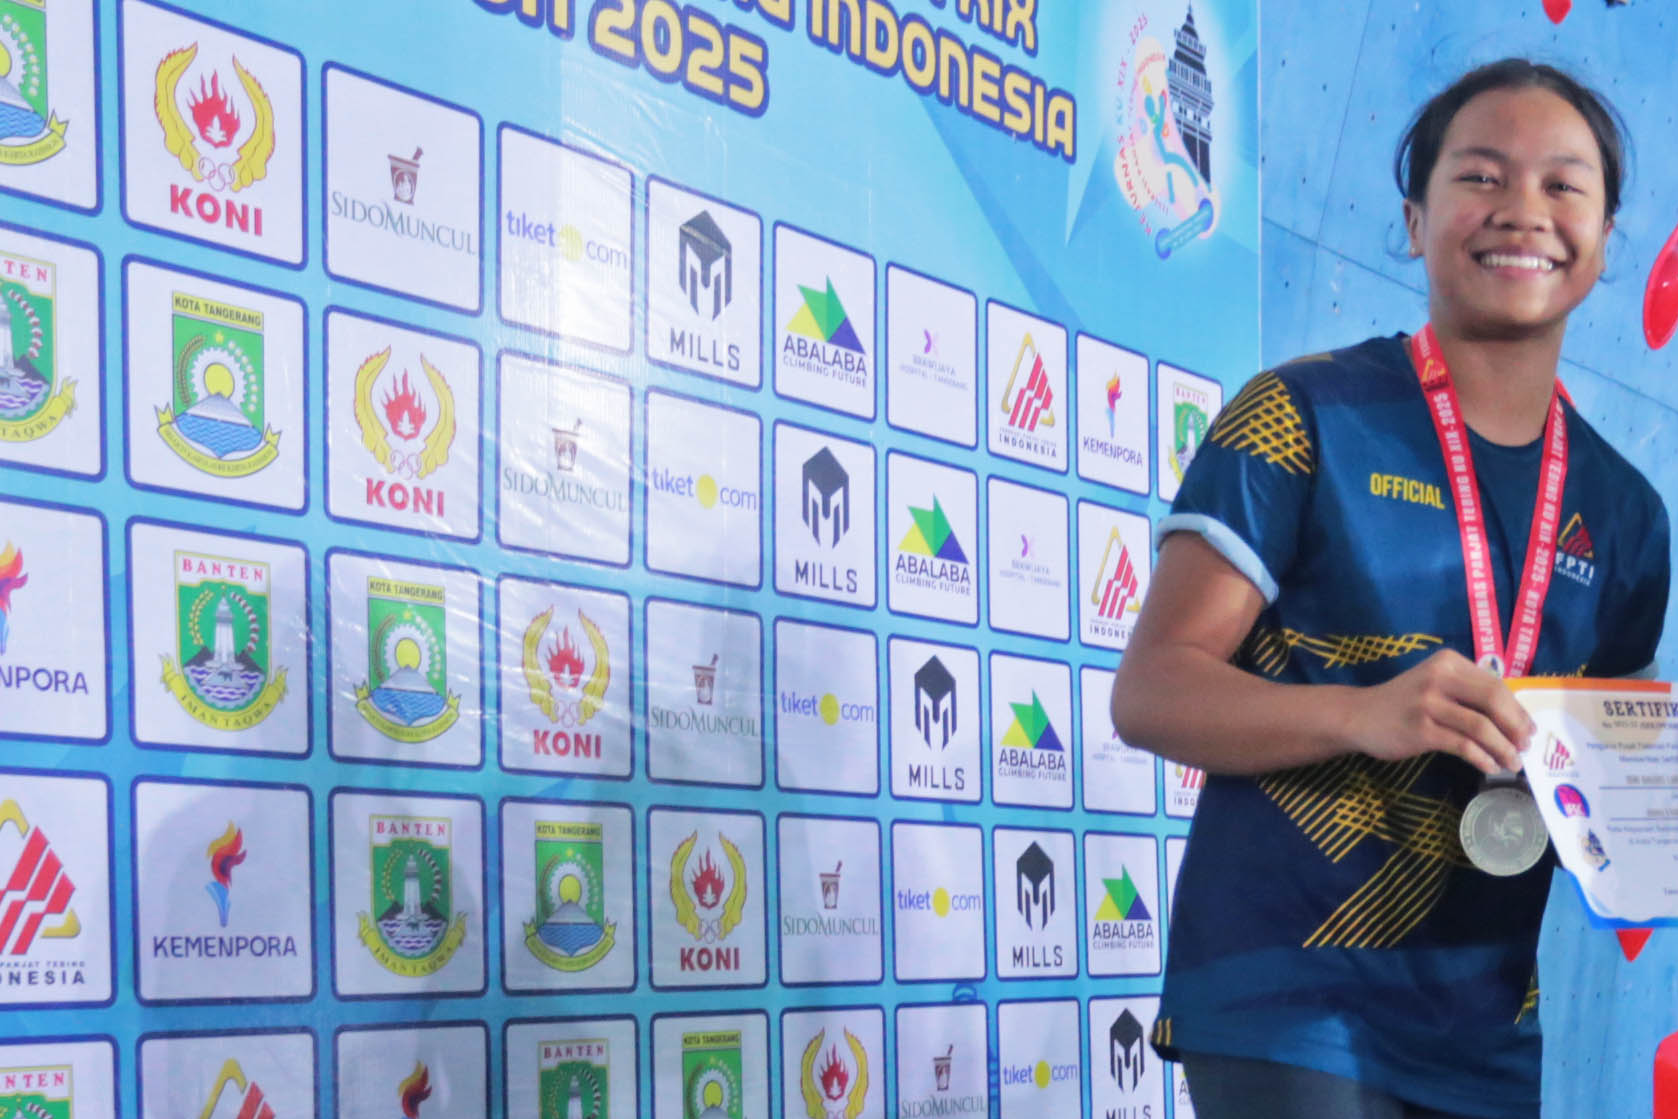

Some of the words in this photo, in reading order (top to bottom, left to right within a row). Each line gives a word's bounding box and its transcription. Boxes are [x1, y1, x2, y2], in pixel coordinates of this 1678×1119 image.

[591, 0, 767, 113] 2025
[809, 0, 1075, 160] INDONESIA
[170, 183, 263, 237] KONI
[332, 190, 478, 257] SIDOMUNCUL
[4, 260, 48, 283] TEN
[174, 296, 201, 313] KOTA
[204, 303, 262, 327] TANGERANG
[670, 327, 740, 372] MILLS
[783, 335, 867, 377] ABALABA
[783, 354, 829, 378] CLIMBING
[832, 366, 866, 388] FUTURE
[999, 433, 1057, 458] INDONESIA
[1083, 435, 1143, 467] KEMENPORA
[365, 477, 445, 518] KONI
[503, 467, 629, 512] SIDOMUNCUL
[1370, 472, 1446, 510] OFFICIAL
[1456, 475, 1476, 522] TEBING
[1466, 526, 1485, 578] PANJAT
[1555, 551, 1595, 579] FPTI
[182, 557, 265, 583] BANTEN
[795, 559, 857, 594] MILLS
[896, 554, 970, 585] ABALABA
[369, 582, 393, 594] KOTA
[394, 584, 443, 601] TANGERANG
[1090, 624, 1128, 639] INDONE
[1473, 582, 1495, 652] KEJURNAS
[1510, 626, 1534, 677] TANGER
[0, 665, 89, 695] NPORA
[650, 705, 759, 738] SIDOMUNCUL
[533, 729, 602, 759] KONI
[999, 749, 1066, 771] ABALABA
[909, 765, 964, 791] MILLS
[376, 821, 446, 837] BANTEN
[783, 913, 879, 937] SIDOMUNCUL
[1093, 922, 1154, 940] ABALABA
[153, 935, 298, 958] KEMENPORA
[680, 947, 741, 972] KONI
[1012, 946, 1063, 968] MILLS
[8, 971, 86, 986] NESIA
[543, 1044, 605, 1059] BANTEN
[4, 1072, 66, 1089] NTEN
[901, 1094, 987, 1119] SIDOMUNCUL
